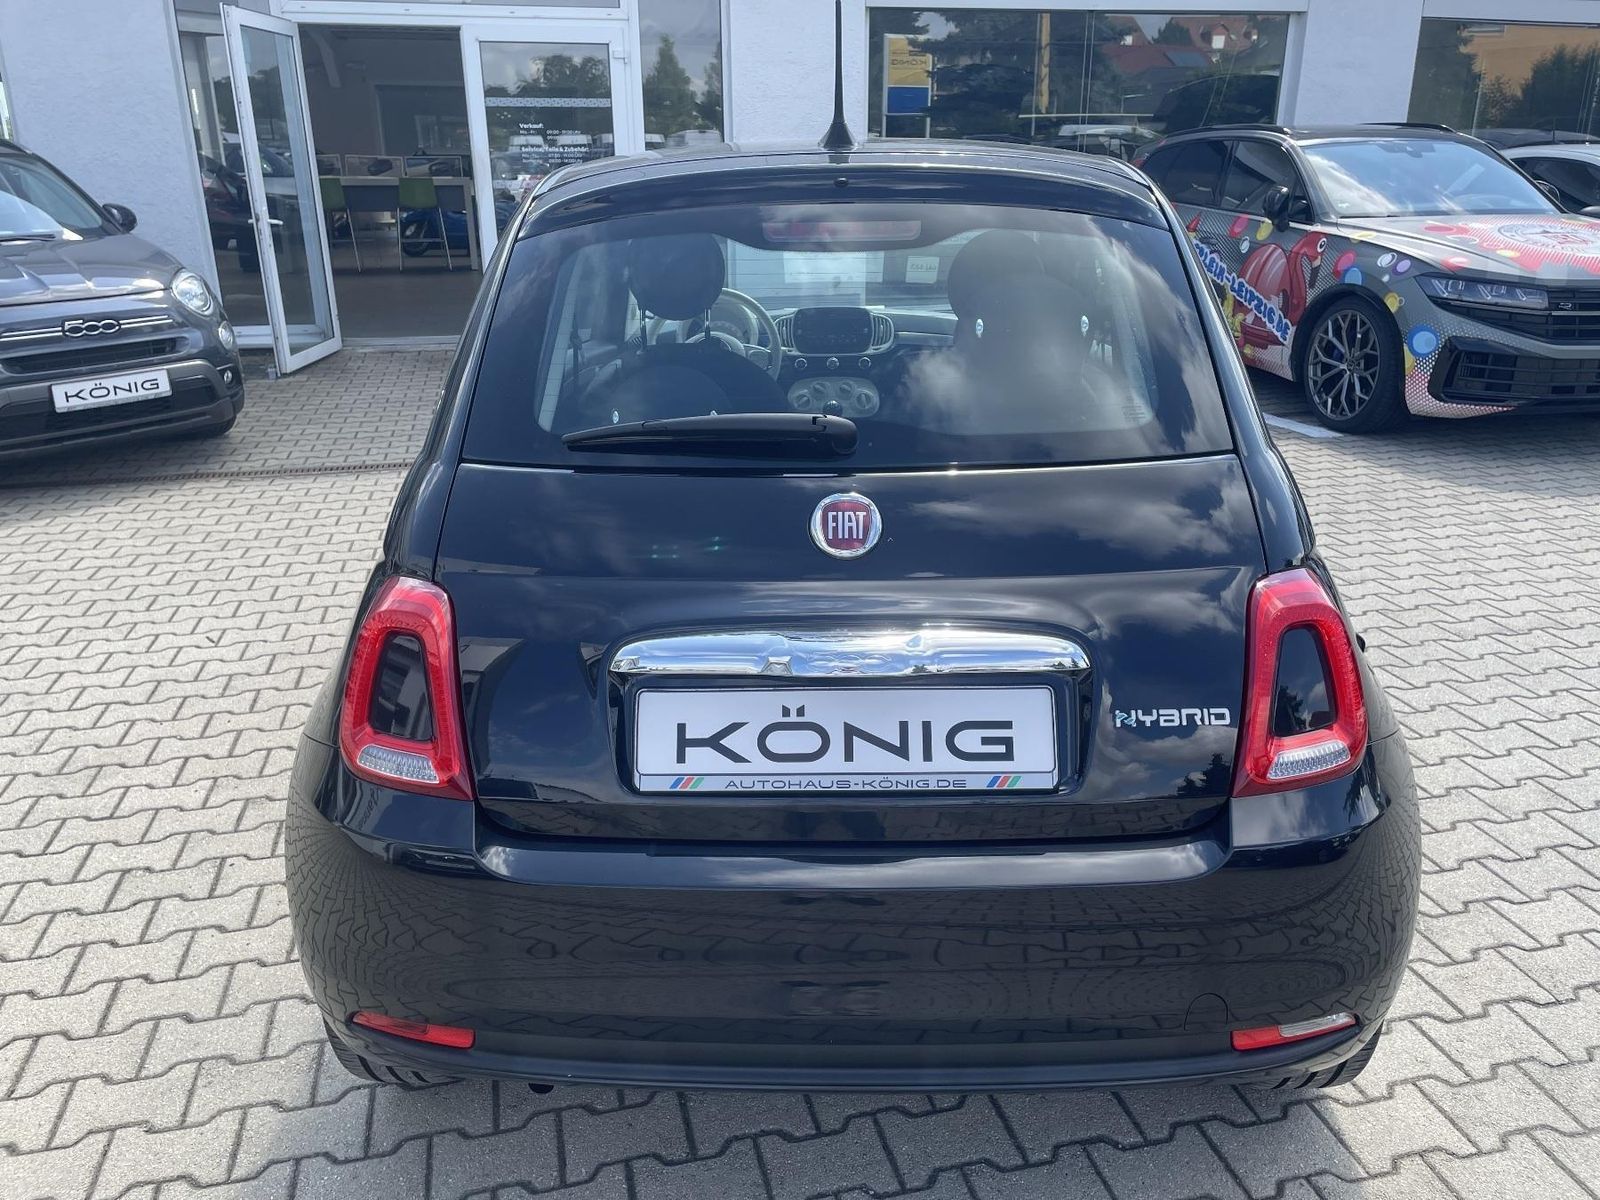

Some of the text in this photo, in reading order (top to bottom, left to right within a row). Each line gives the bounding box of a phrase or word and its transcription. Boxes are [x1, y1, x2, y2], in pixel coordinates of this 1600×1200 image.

[64, 319, 120, 337] 500
[64, 378, 160, 403] KÖNIG
[827, 511, 867, 540] FIAT
[1114, 708, 1231, 727] HYBRID
[676, 704, 1015, 764] KÖNIG
[724, 774, 968, 790] AUTOHAUS-KÖNIG.DE
